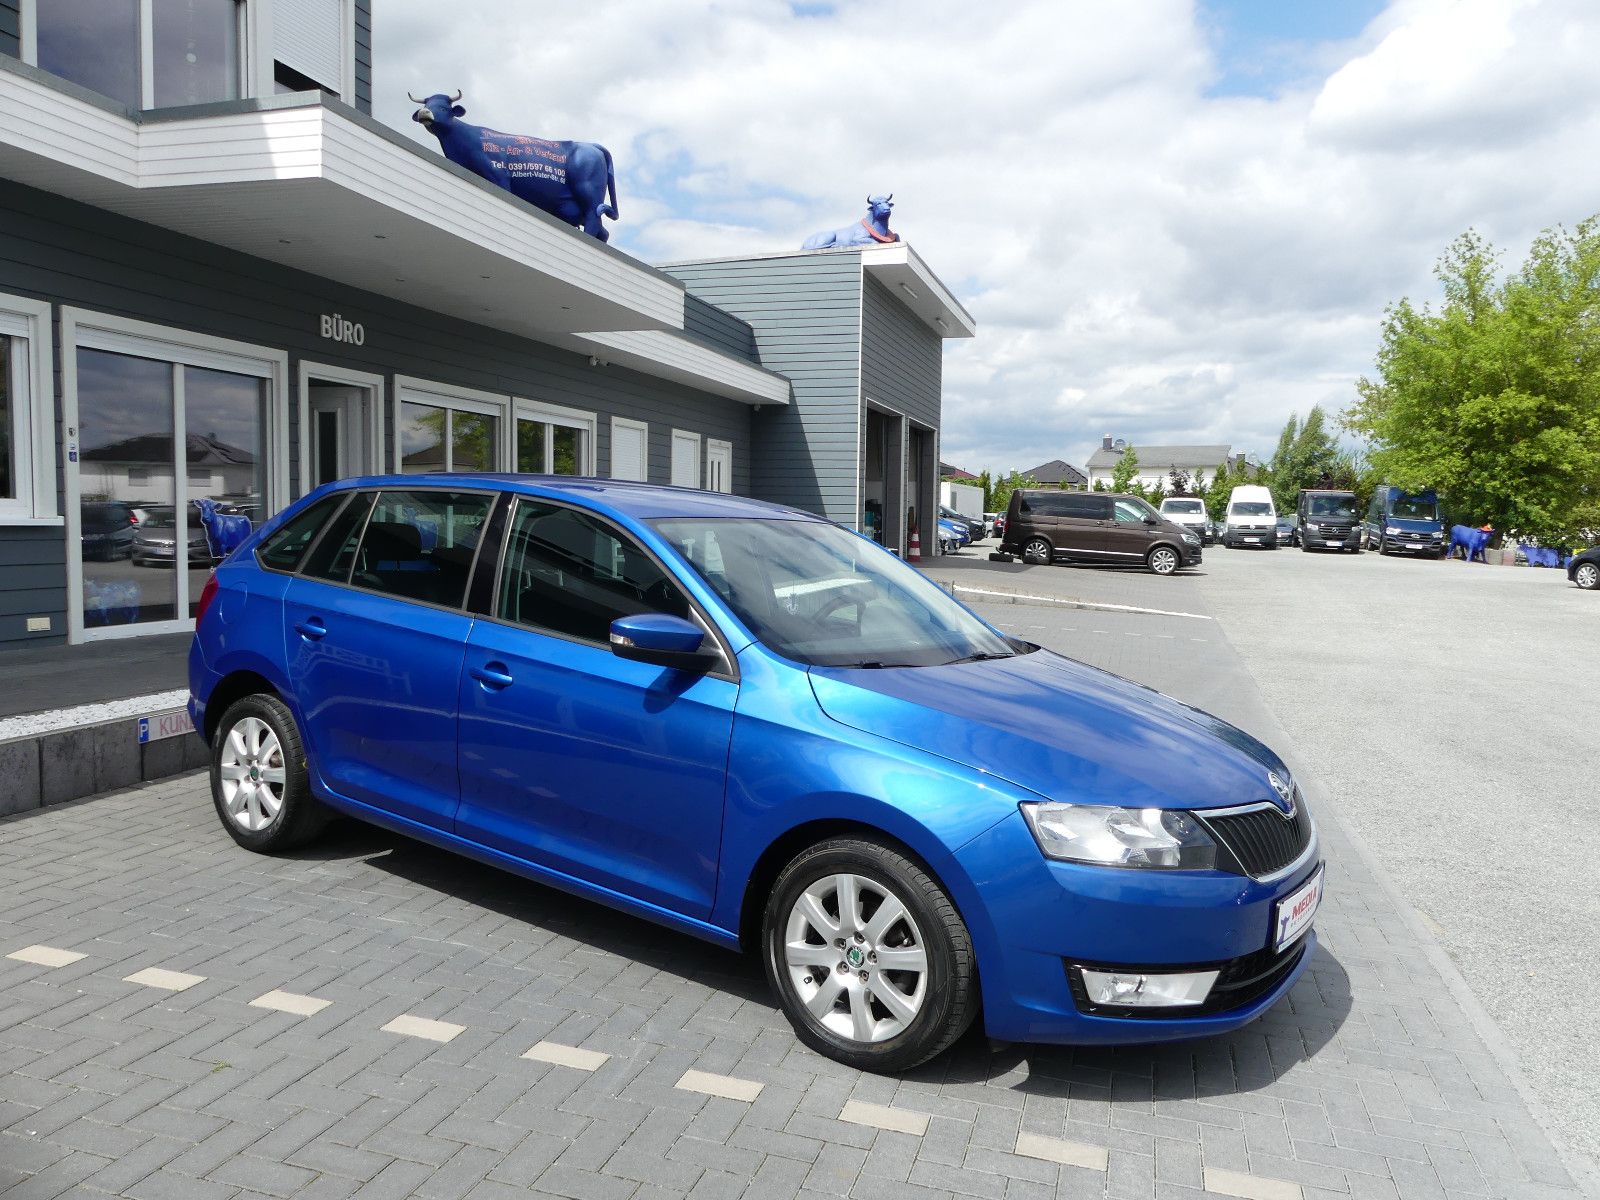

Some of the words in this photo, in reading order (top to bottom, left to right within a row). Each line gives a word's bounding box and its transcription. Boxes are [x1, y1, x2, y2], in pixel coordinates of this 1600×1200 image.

[491, 160, 507, 169] Tel.
[508, 163, 543, 171] 0391/597
[553, 168, 566, 177] 100
[320, 313, 365, 346] BÜRO
[140, 724, 149, 738] P
[1292, 887, 1318, 920] MEDIA
